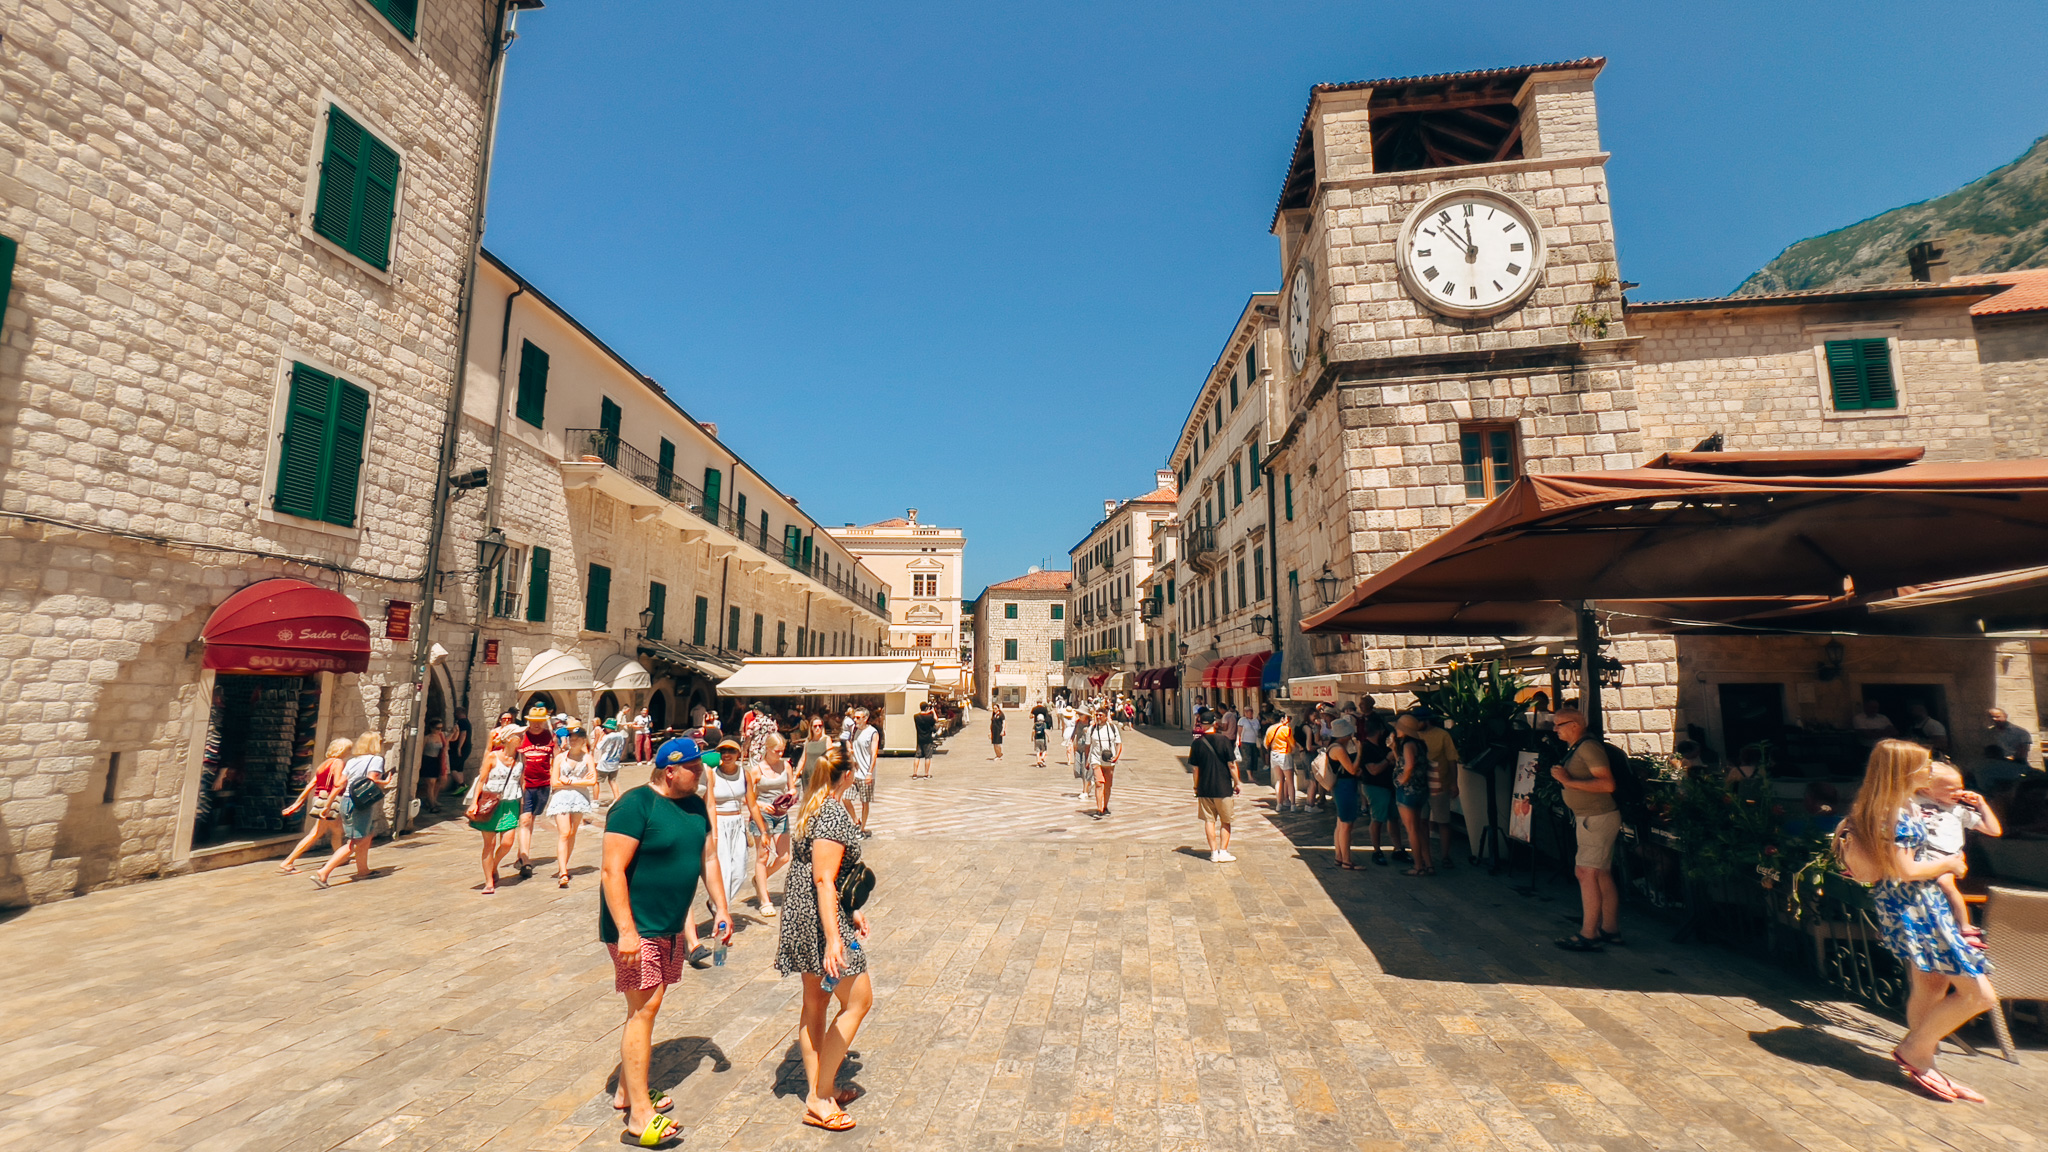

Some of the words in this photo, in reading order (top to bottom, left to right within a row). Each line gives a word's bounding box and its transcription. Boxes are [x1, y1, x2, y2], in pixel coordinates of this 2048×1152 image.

[1463, 204, 1474, 217] XII
[1510, 242, 1524, 252] III
[298, 628, 338, 640] Sailor
[248, 655, 335, 669] SOUVENIR
[336, 659, 347, 669] &
